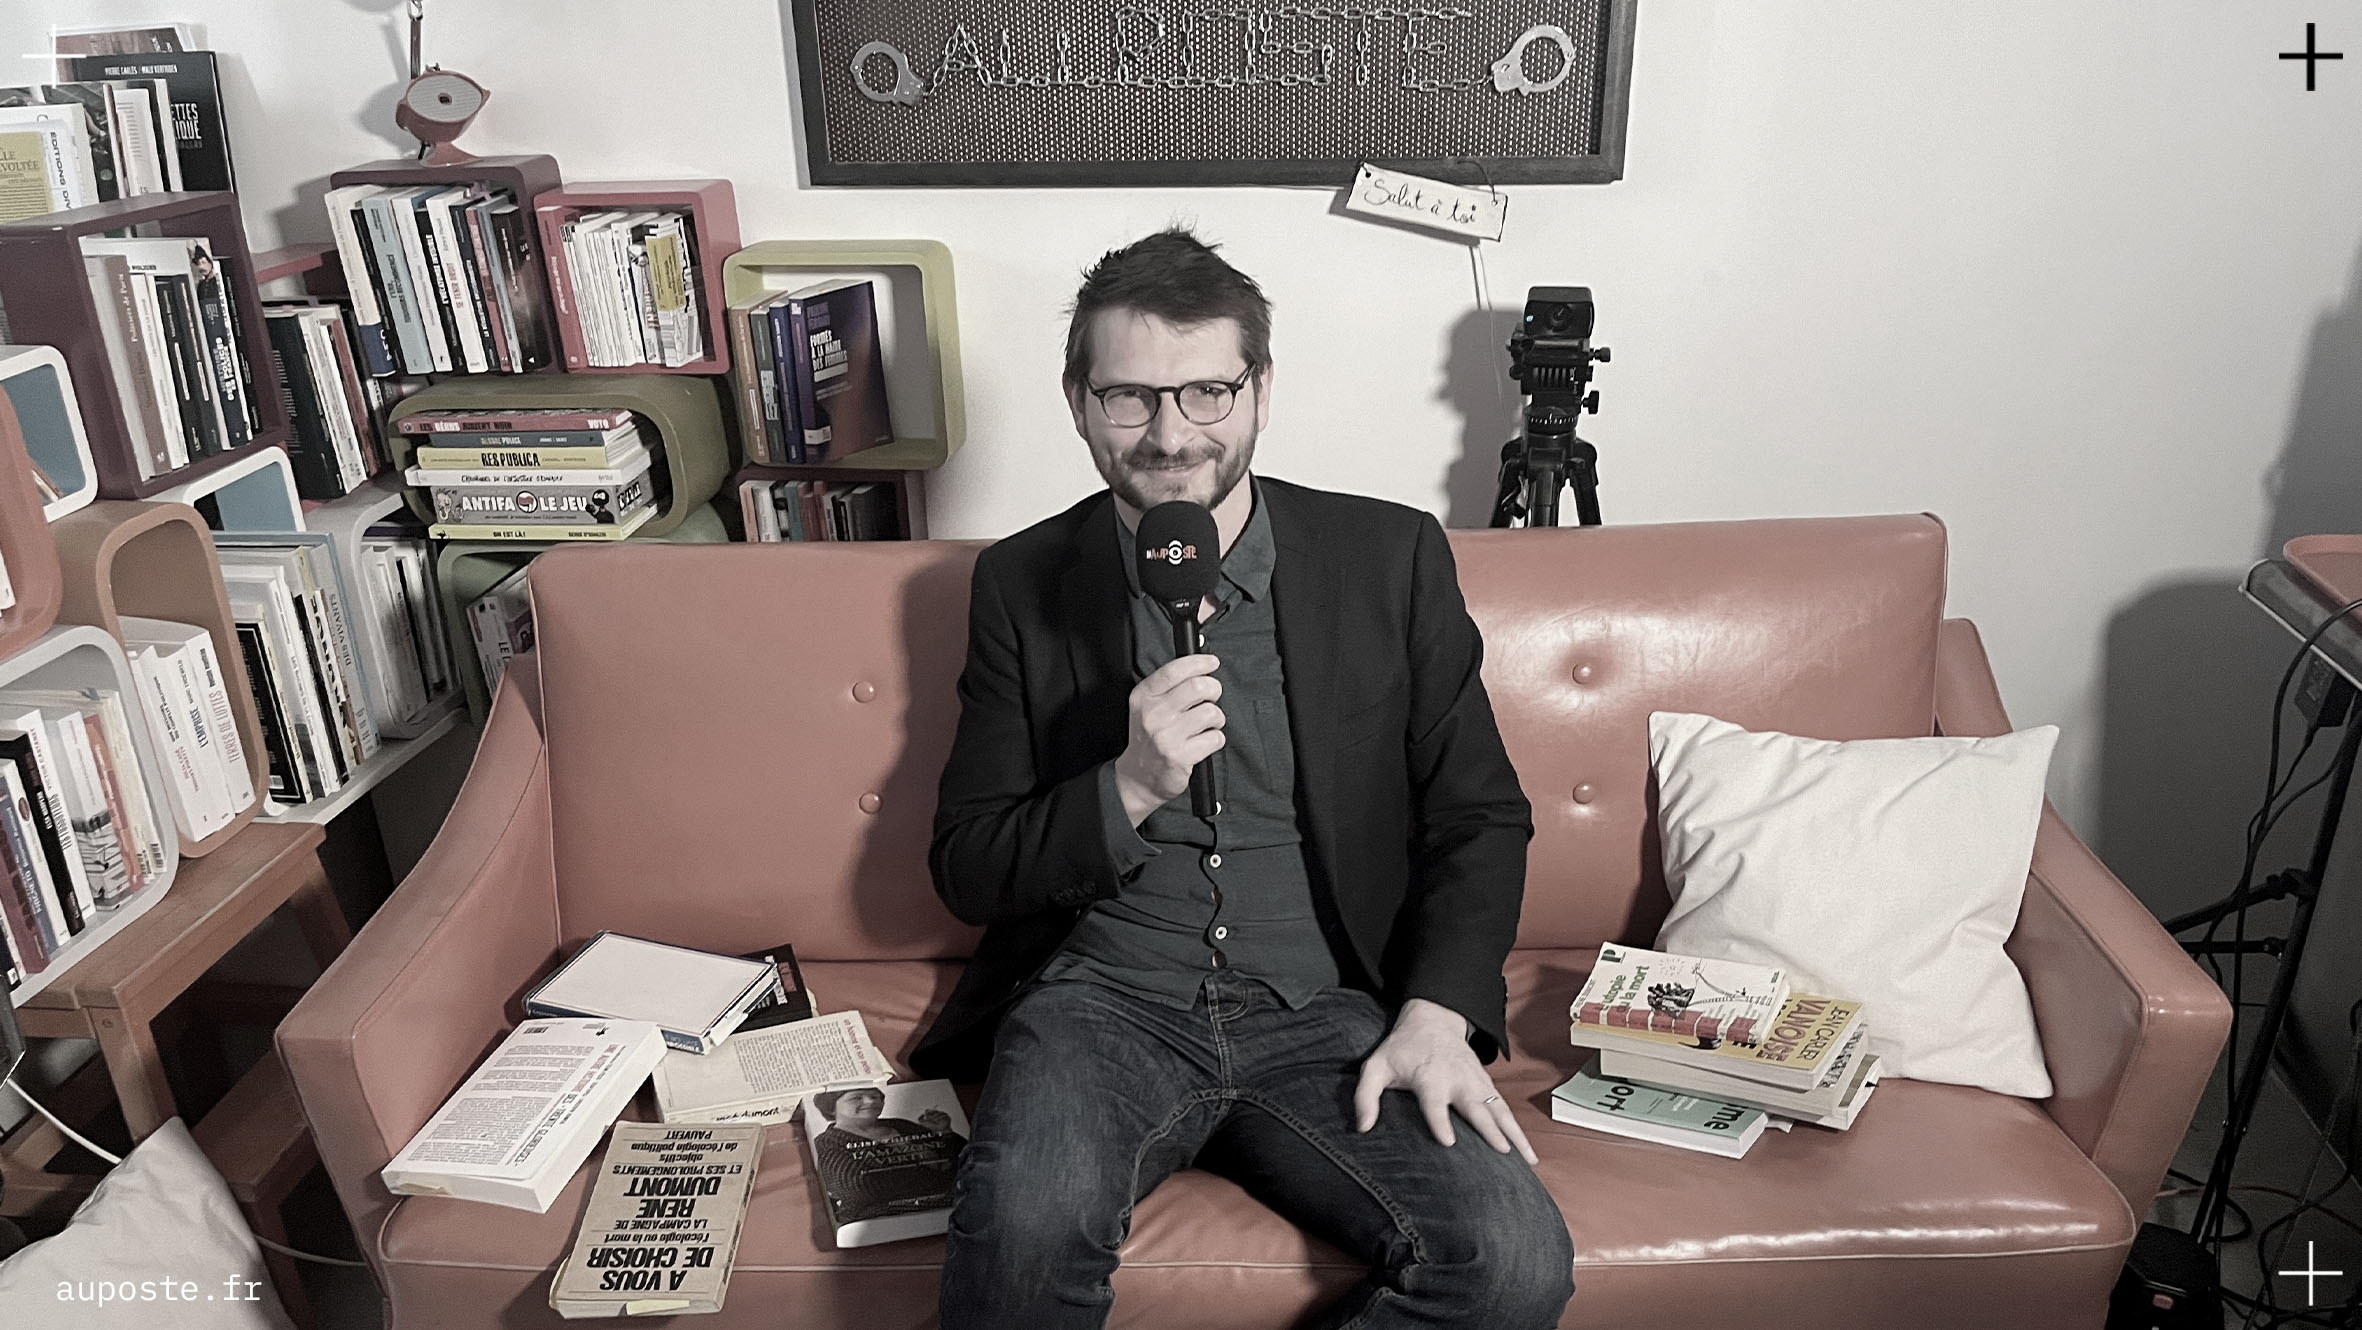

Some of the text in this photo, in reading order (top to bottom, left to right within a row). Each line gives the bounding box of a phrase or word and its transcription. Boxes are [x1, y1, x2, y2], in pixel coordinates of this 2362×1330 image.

[1364, 179, 1477, 224] Salut à toi
[481, 452, 541, 467] RES PUBLICA
[462, 495, 588, 511] ANTIFA LE JEU
[330, 594, 352, 666] DES VIVANTS
[208, 690, 228, 721] LUTTES
[190, 706, 208, 749] L'EMPRISE
[218, 721, 232, 733] DE
[31, 728, 44, 764] CASTANET
[225, 732, 241, 763] TERRES
[40, 764, 53, 791] VICTOR
[1629, 965, 1649, 991] mort
[1756, 1000, 1832, 1062] VANOISE
[664, 1131, 712, 1140] PAUVERT
[631, 1142, 738, 1152] de l'écologie politique
[659, 1153, 703, 1162] objectifs
[613, 1164, 743, 1175] ET SES PROLONGEMENTS
[623, 1176, 721, 1197] DUMONT
[614, 1219, 708, 1230] LA CAMPAGNE DE
[604, 1233, 710, 1243] l'écologie ou la mort
[587, 1247, 715, 1267] DE CHOISIR
[600, 1270, 687, 1291] A VOUS
